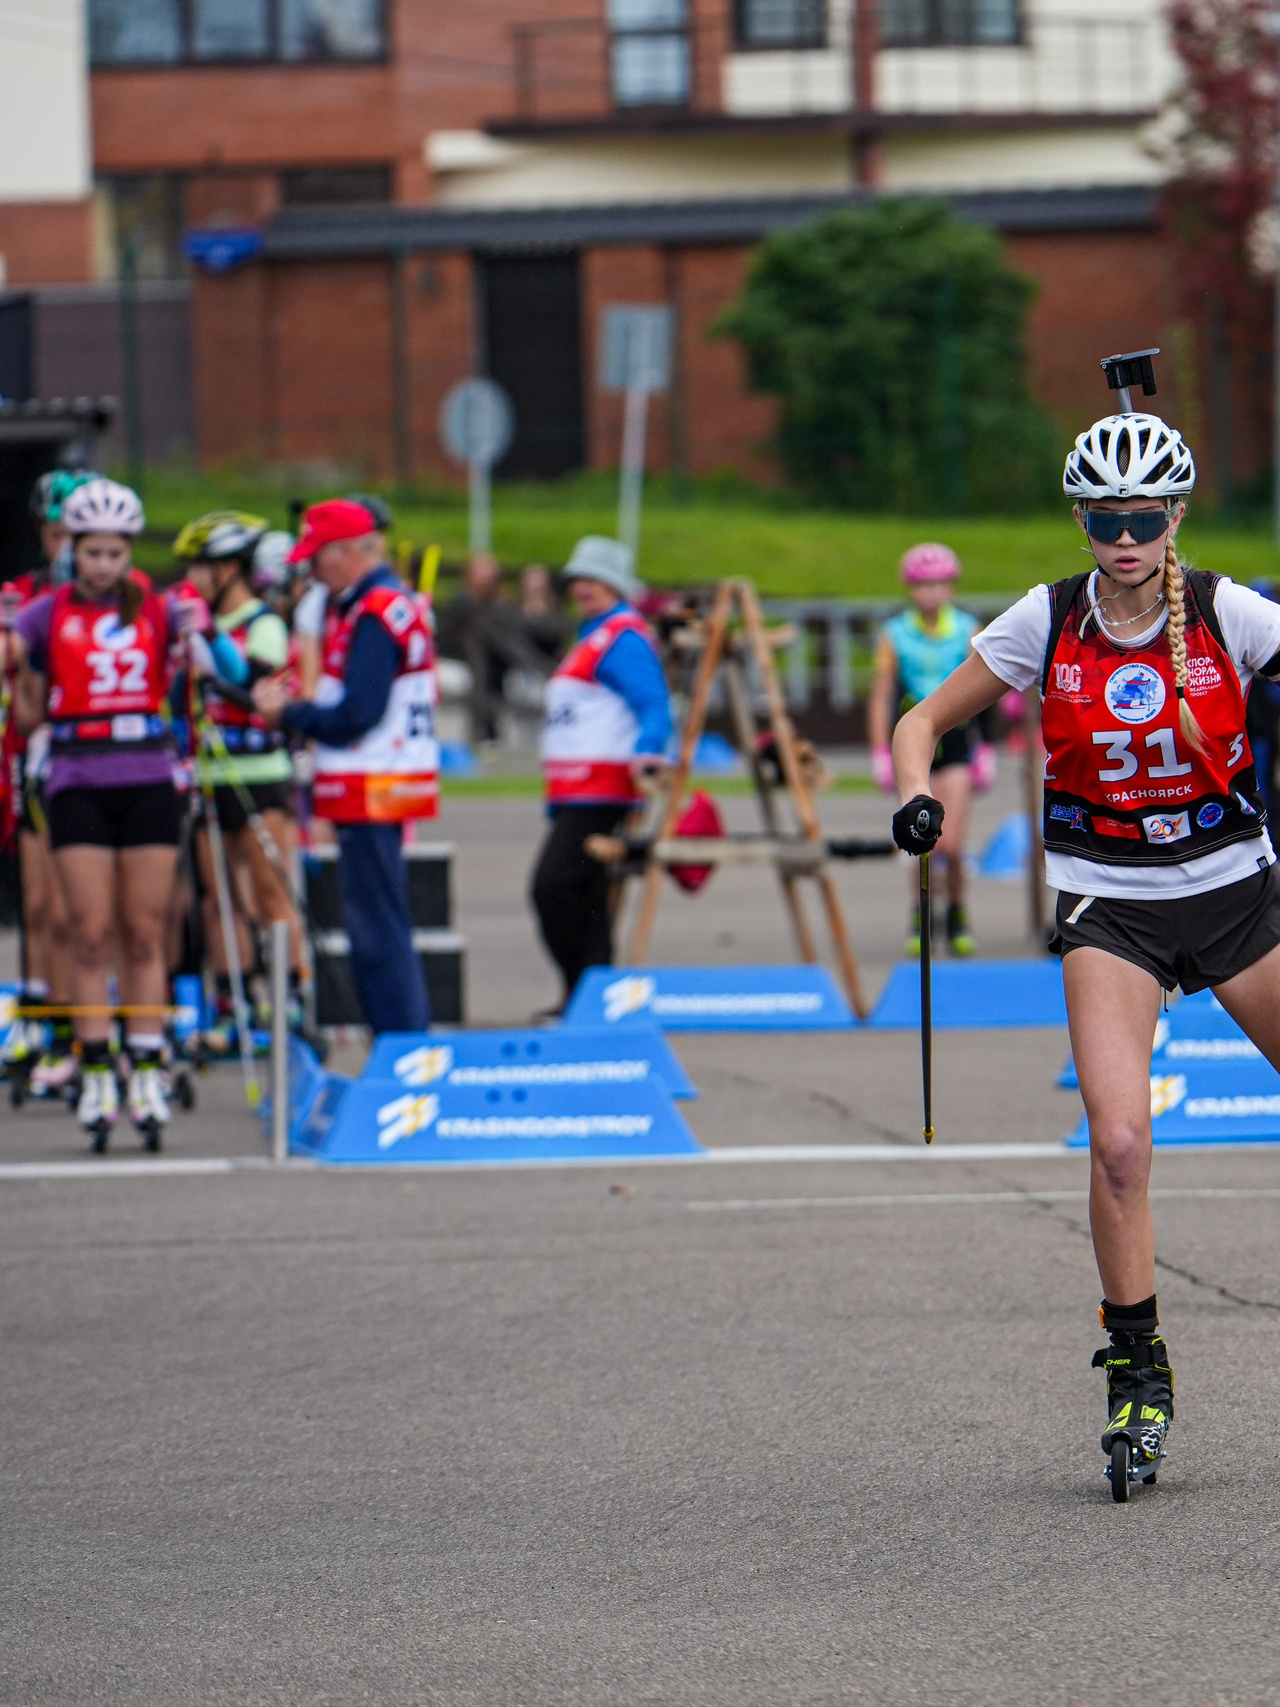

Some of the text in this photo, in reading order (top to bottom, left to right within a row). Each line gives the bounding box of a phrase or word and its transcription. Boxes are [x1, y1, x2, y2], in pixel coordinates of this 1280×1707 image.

[86, 649, 148, 694] 32
[1092, 728, 1192, 782] 31
[436, 1115, 653, 1139] KRASINDORSTROY
